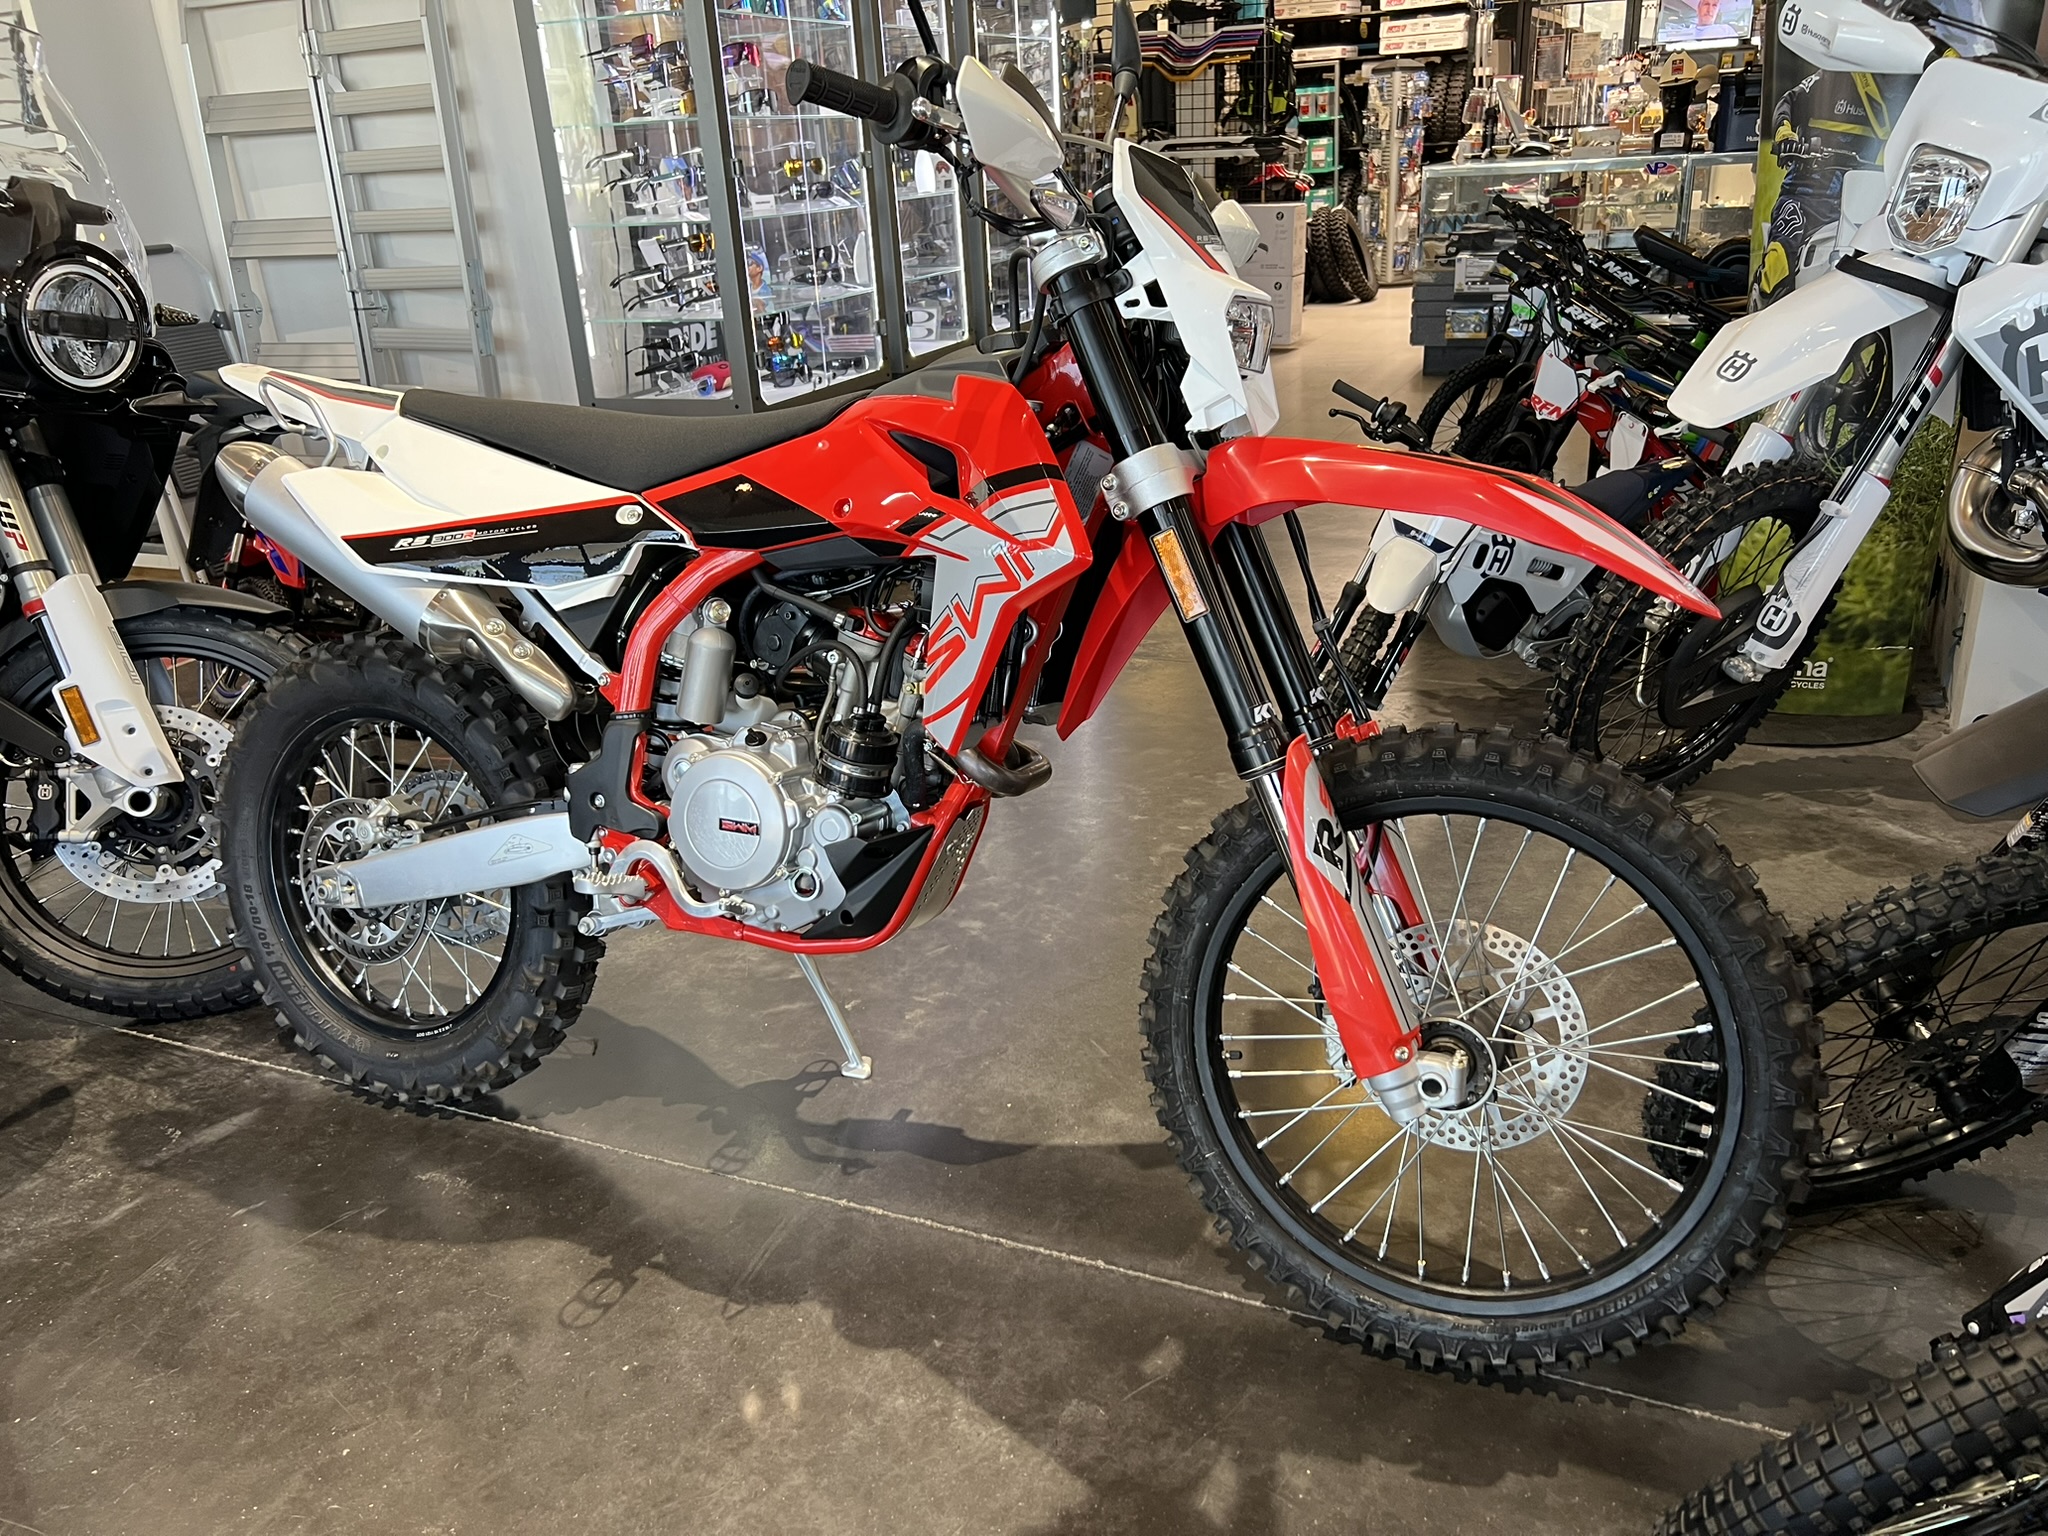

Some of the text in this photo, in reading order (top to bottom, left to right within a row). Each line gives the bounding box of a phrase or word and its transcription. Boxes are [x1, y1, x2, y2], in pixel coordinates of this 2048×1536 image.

[1602, 260, 1640, 287] RFN
[1565, 303, 1606, 330] RFN
[1531, 393, 1562, 419] RFN
[394, 535, 431, 549] RS
[271, 964, 349, 1043] MICHELIN
[1575, 1277, 1660, 1325] MICHELIN
